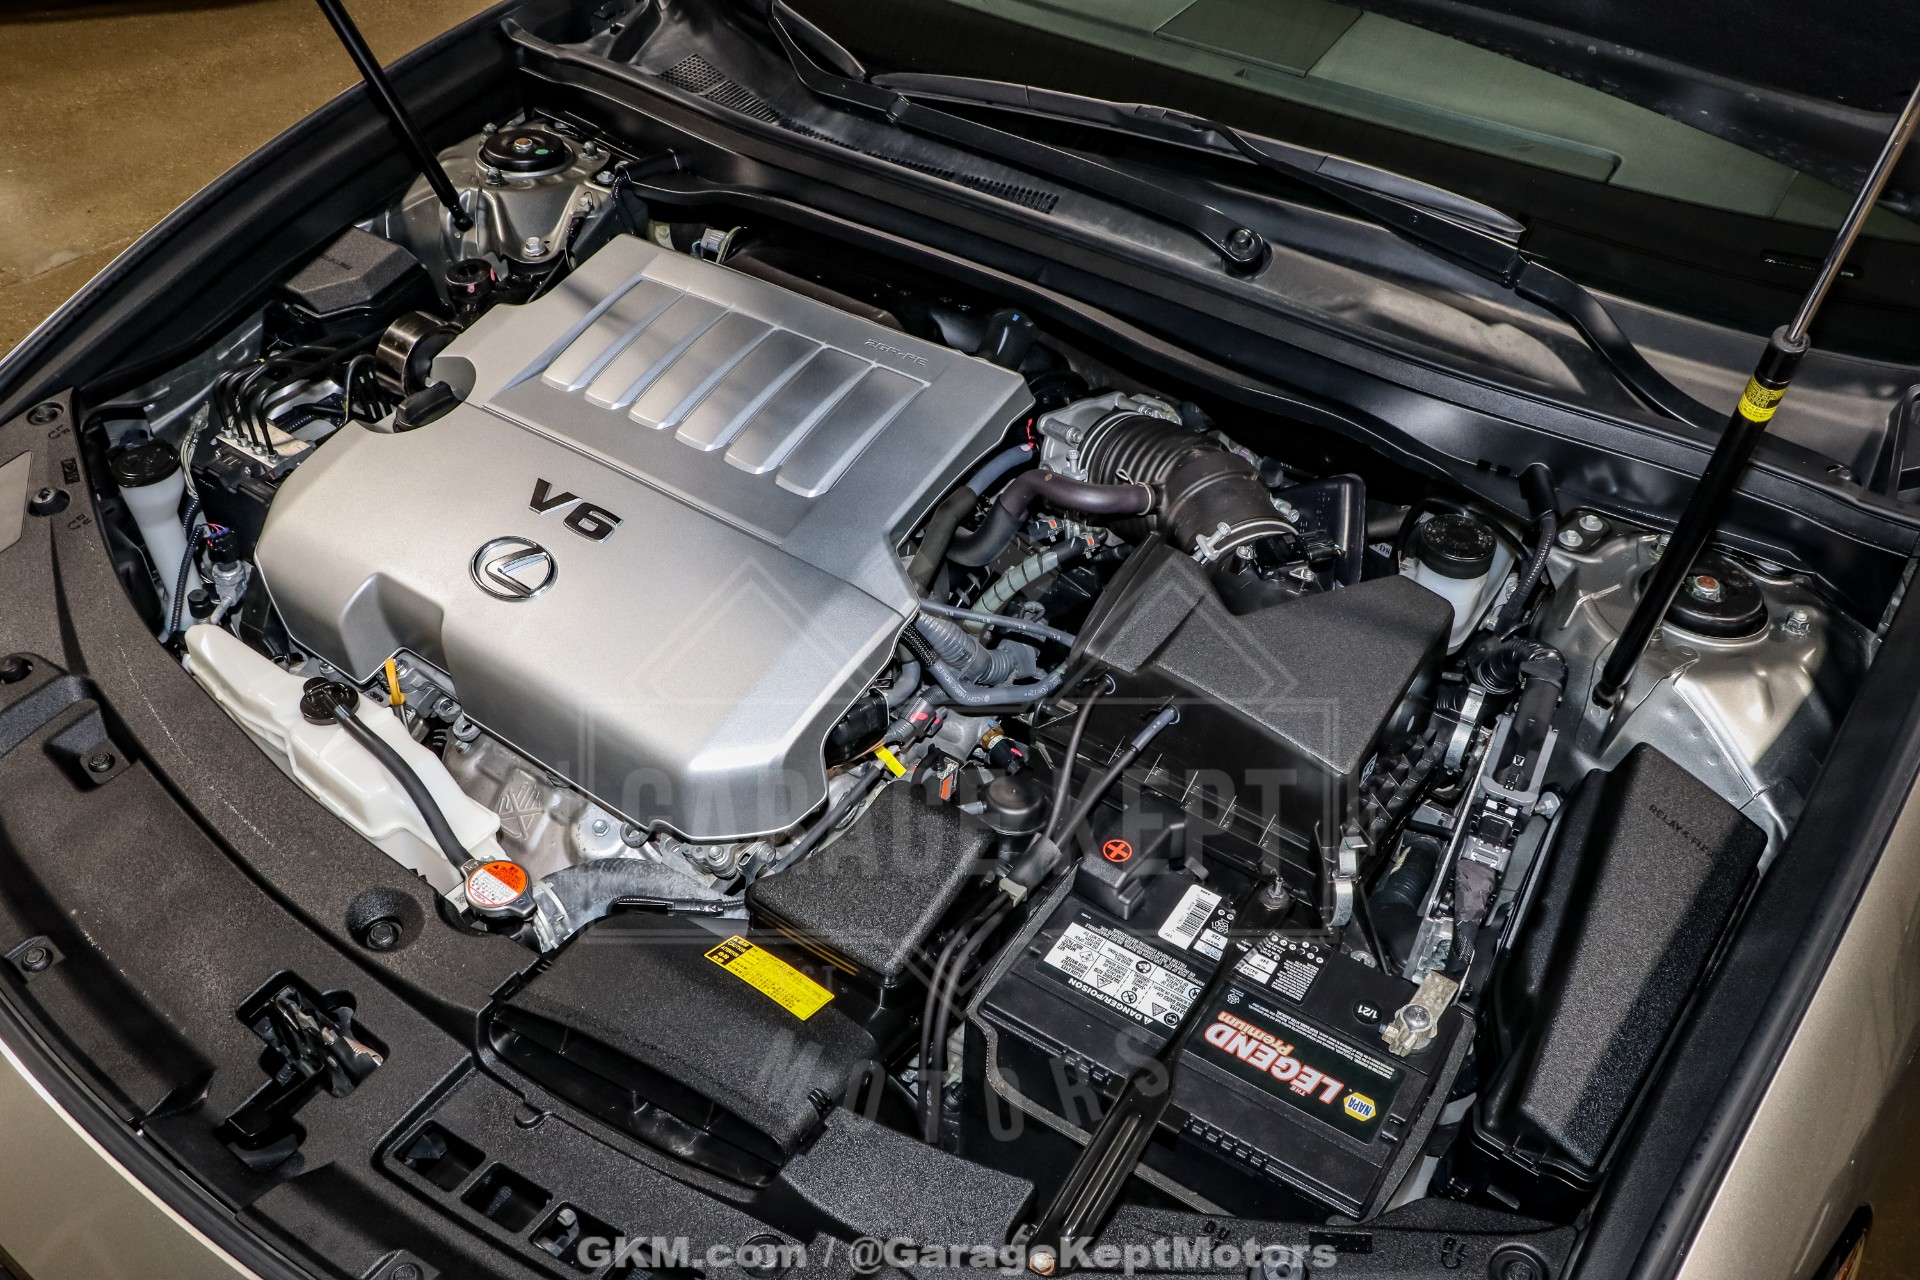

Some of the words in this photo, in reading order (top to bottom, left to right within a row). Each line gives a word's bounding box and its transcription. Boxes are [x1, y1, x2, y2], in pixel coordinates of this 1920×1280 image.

[529, 478, 624, 543] V6
[1068, 977, 1143, 1020] DANGER/POISON
[1358, 1003, 1380, 1021] 1/21
[1217, 1011, 1294, 1058] Premium
[1204, 1022, 1344, 1105] LEGEND
[1289, 1084, 1306, 1096] THE
[1346, 1095, 1374, 1117] NAPA
